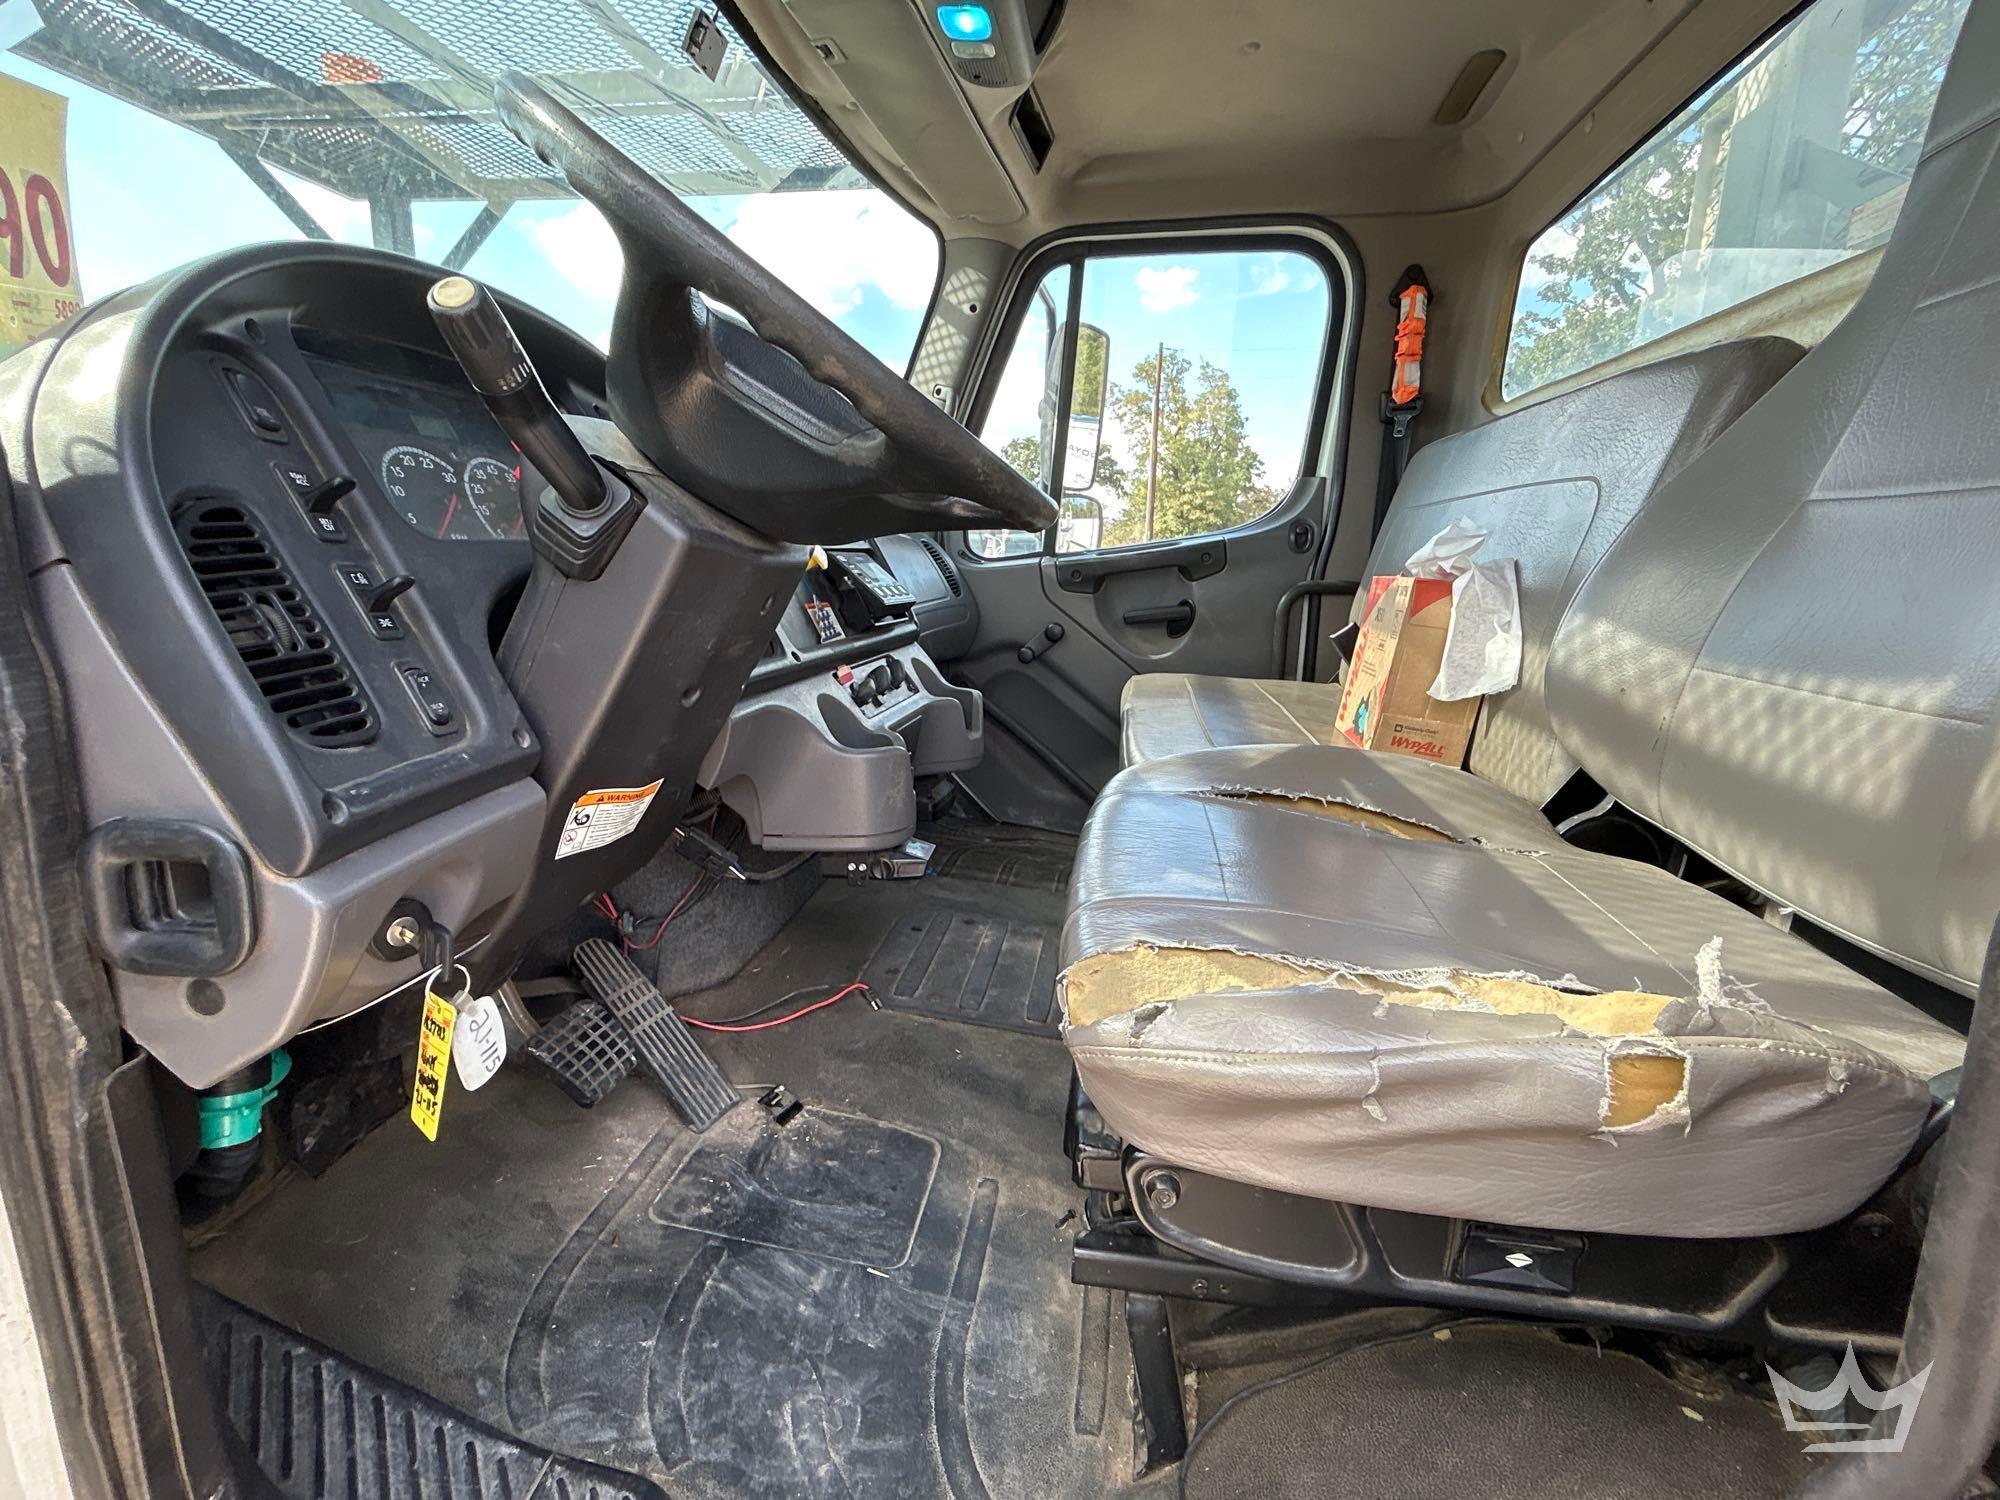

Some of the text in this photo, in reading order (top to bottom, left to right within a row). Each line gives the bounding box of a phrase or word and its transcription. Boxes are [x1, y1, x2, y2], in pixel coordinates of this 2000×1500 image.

[399, 454, 415, 467] 20
[419, 456, 434, 469] 25
[390, 465, 405, 478] 15
[441, 472, 457, 484] 30
[390, 485, 406, 497] 10
[470, 483, 485, 494] 25
[477, 505, 490, 516] 15
[408, 512, 417, 524] 5
[469, 1009, 501, 1072] 21-115
